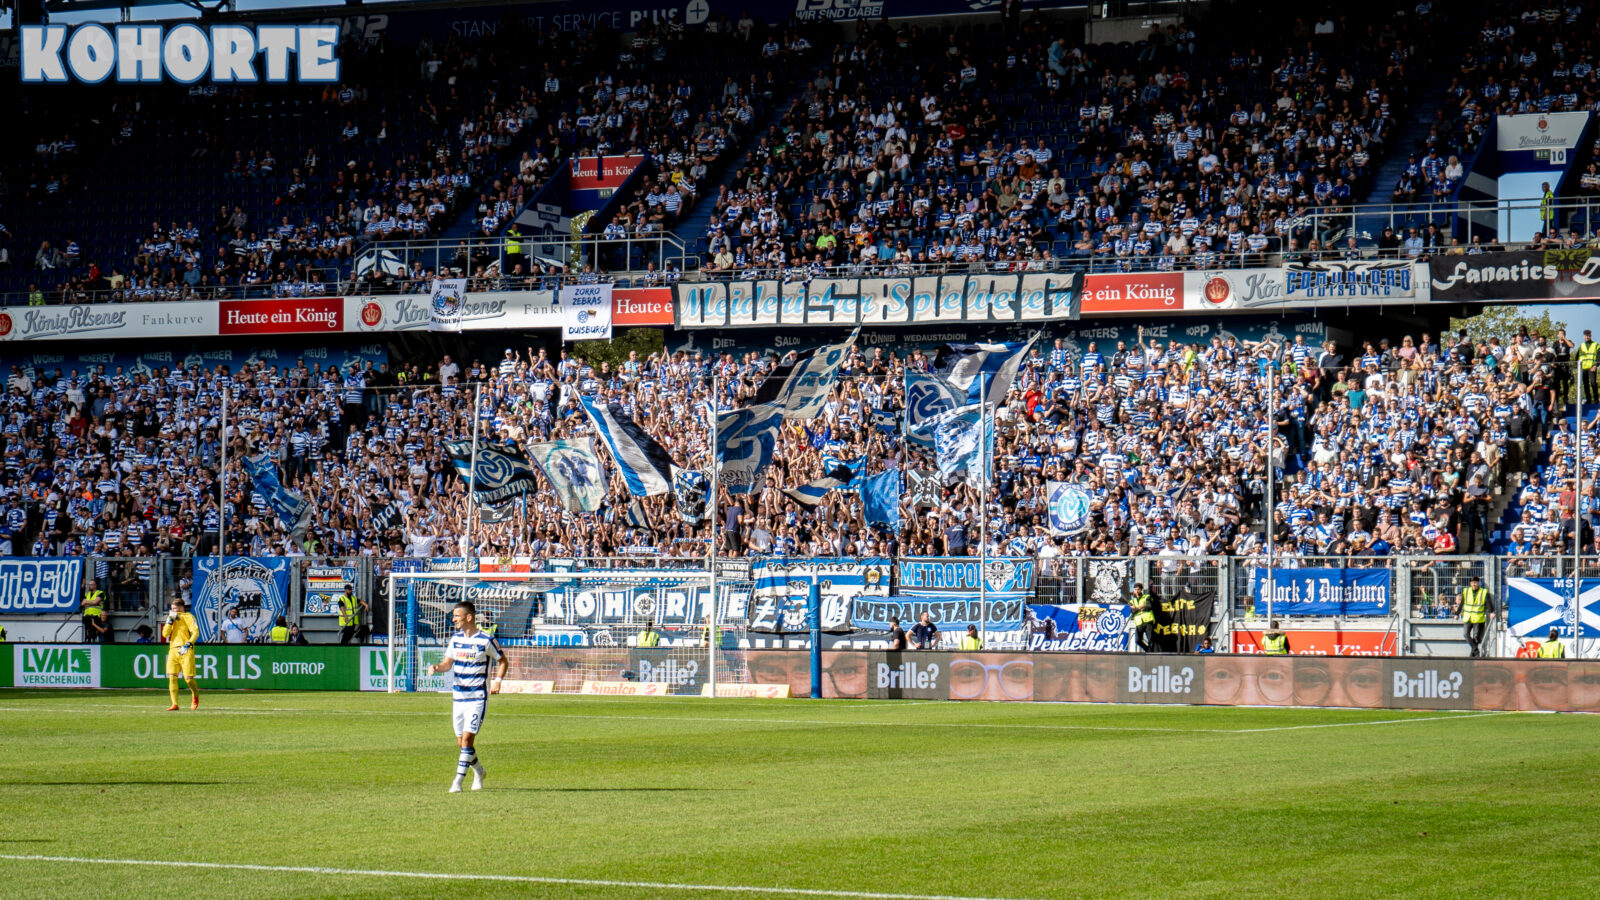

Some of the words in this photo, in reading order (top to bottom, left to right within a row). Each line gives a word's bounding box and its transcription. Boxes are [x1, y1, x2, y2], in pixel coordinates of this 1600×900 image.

[818, 9, 845, 19] SIND
[849, 7, 883, 18] DABEI
[1532, 151, 1544, 161] 10
[572, 297, 602, 306] ZEBRAS
[1096, 286, 1121, 300] ein
[1126, 283, 1175, 305] König
[616, 299, 662, 314] Heute
[22, 309, 68, 334] König
[68, 306, 127, 329] Pilsener
[143, 313, 204, 325] Fankurve
[227, 310, 268, 325] Heute
[271, 309, 292, 323] ein
[296, 308, 337, 328] König
[568, 326, 606, 334] DUISBURG
[904, 333, 967, 342] WEDAUSTADION
[1186, 325, 1210, 337] HOPP
[713, 337, 736, 349] DIETZ
[1013, 561, 1033, 588] 47
[1319, 578, 1386, 608] Duisburg
[854, 599, 1021, 624] WEDAUSTADION
[1161, 599, 1196, 612] ELITE
[22, 649, 71, 673] LVM
[133, 654, 218, 679] OLER
[227, 654, 261, 680] LIS
[272, 662, 325, 675] BOTTROP
[22, 675, 92, 685] VERSICHERUNG
[639, 659, 698, 685] Brille?
[877, 662, 939, 688] Brille?
[1128, 665, 1194, 693] Brille?
[590, 682, 636, 694] Sinalco
[1393, 670, 1463, 699] Brille?
